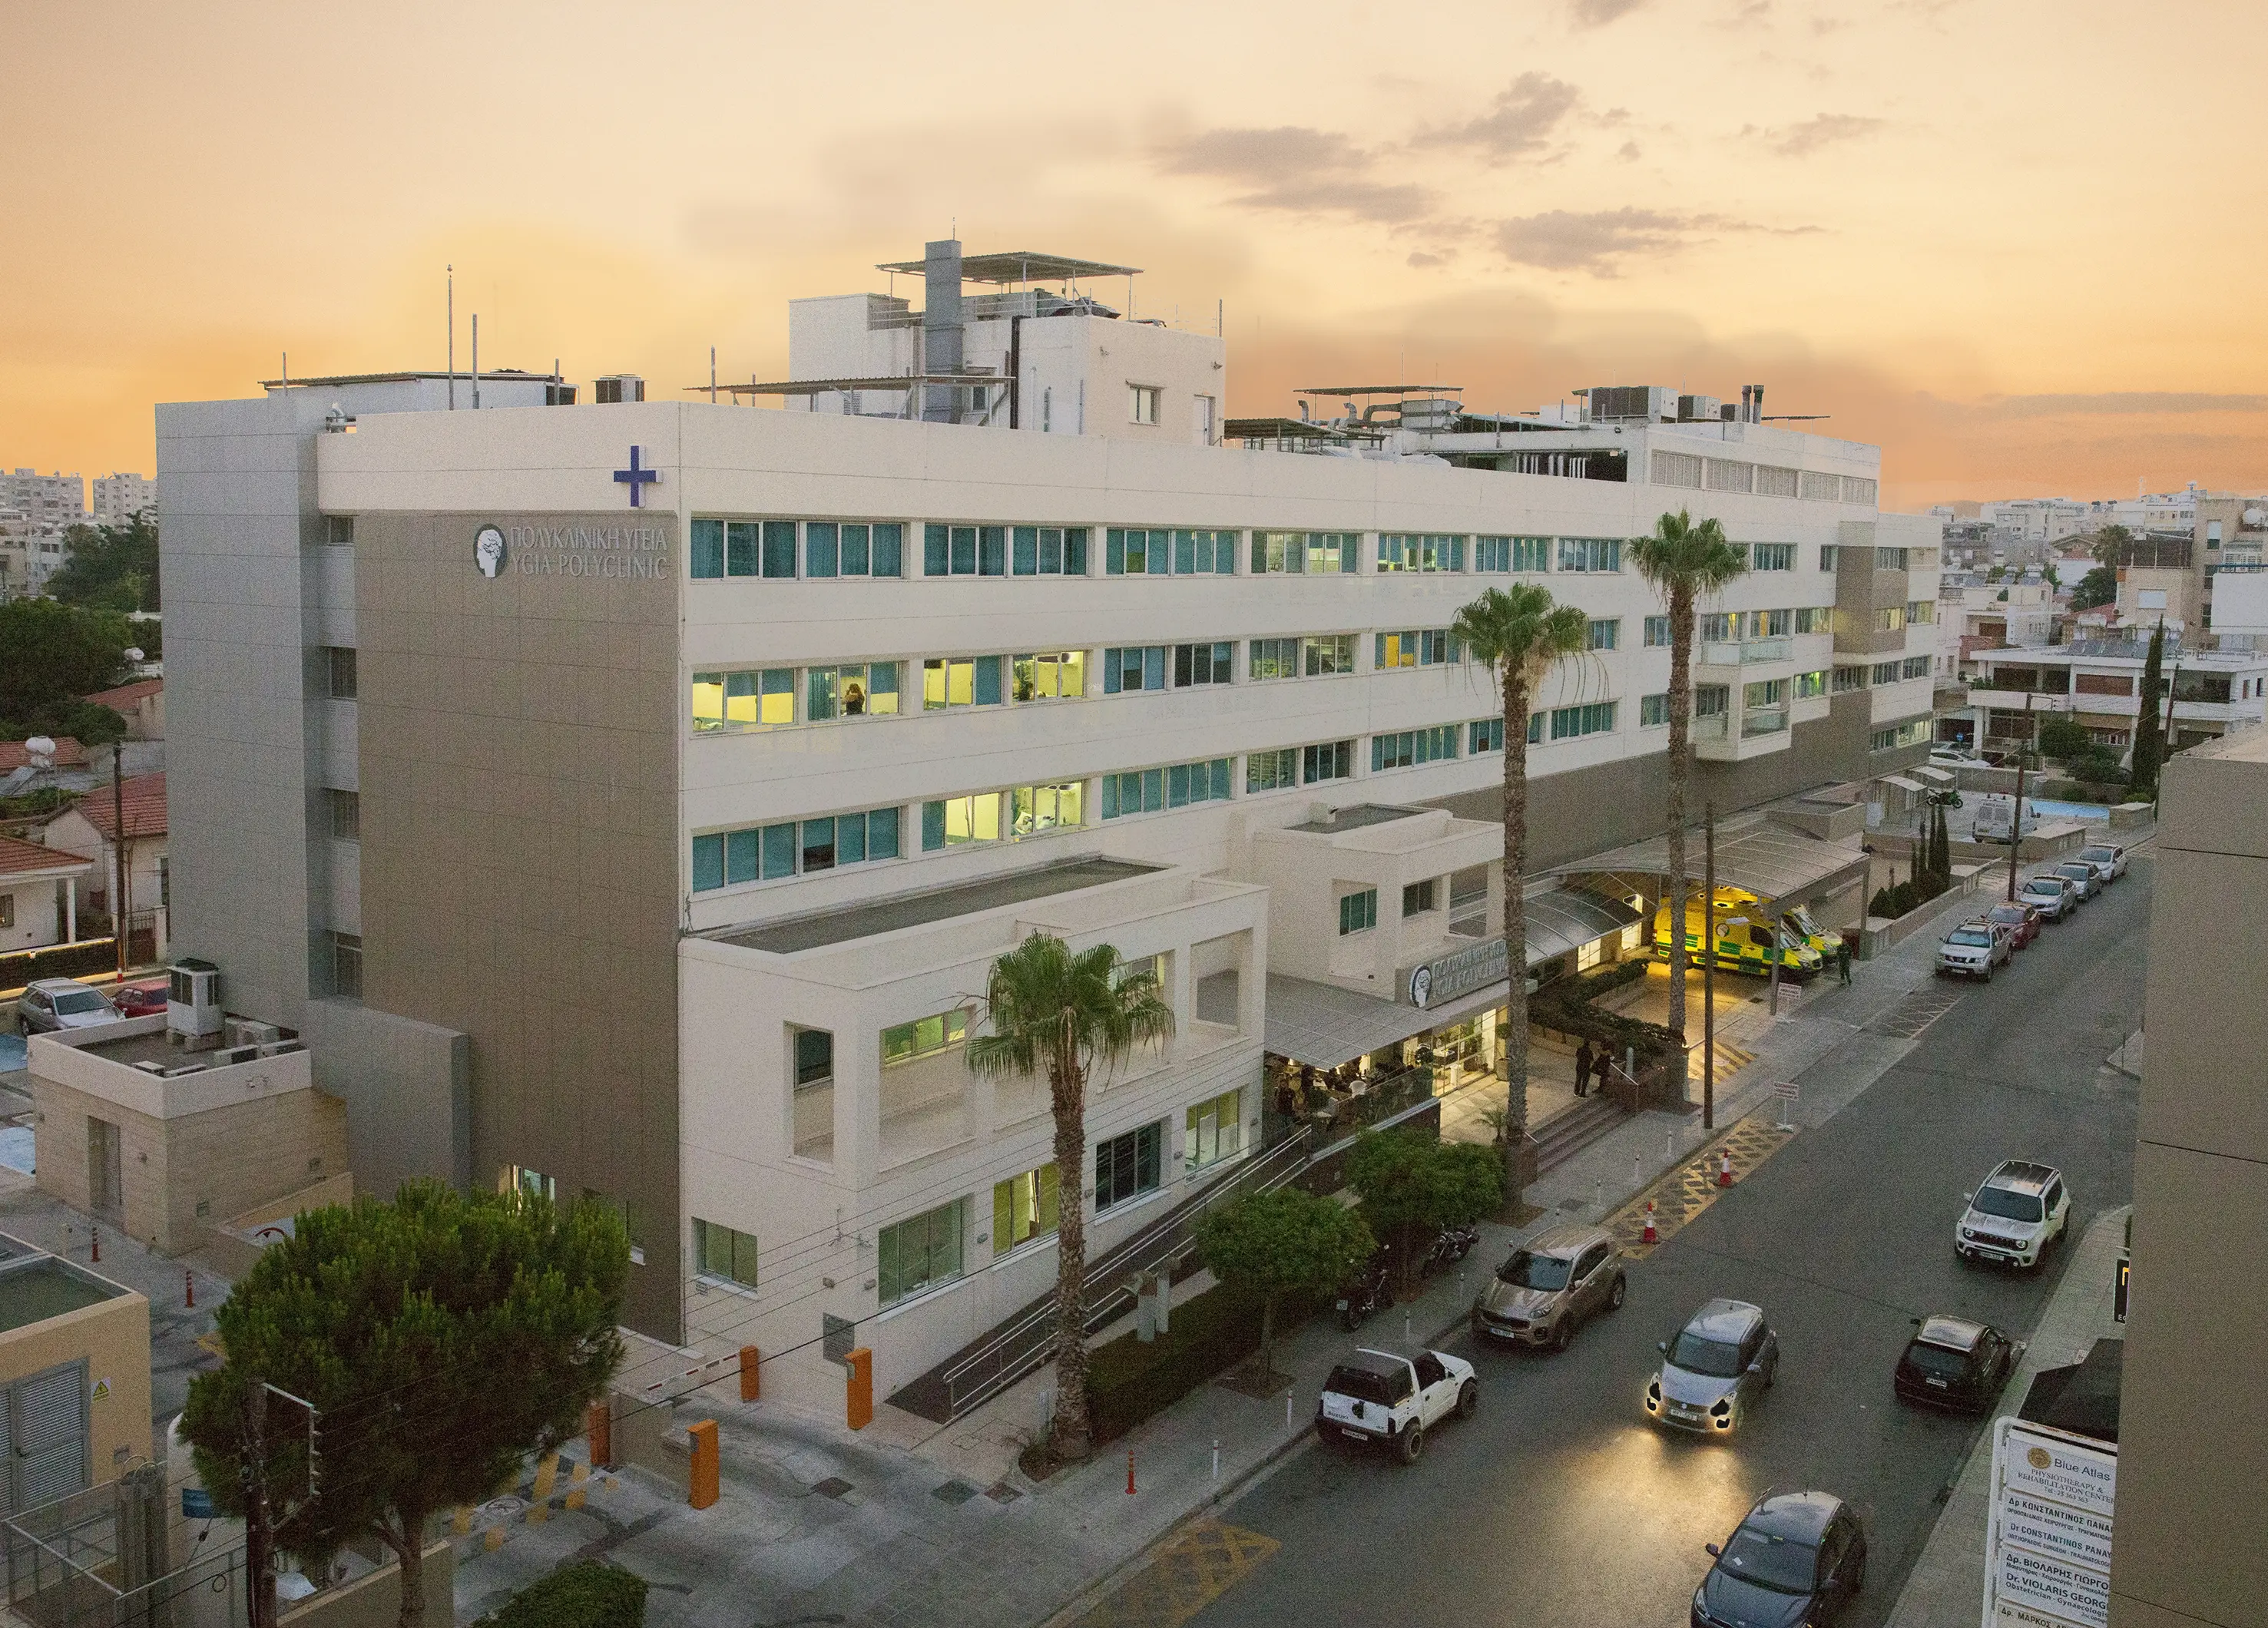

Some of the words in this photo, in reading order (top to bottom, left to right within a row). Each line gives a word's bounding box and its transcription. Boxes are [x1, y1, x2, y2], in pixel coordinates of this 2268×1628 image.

[510, 527, 620, 550] ΠΟΛΥΚΛΙΝΙΚΗ
[624, 528, 667, 551] ΥΓΕΙΑ
[512, 553, 551, 575] YGIA
[559, 554, 667, 581] POLYCLINIC
[1327, 1411, 1349, 1420] SUZUKI
[2031, 1468, 2096, 1491] PHYSIOTHERAPY
[2054, 1458, 2079, 1473] Blue
[2081, 1466, 2111, 1481] Atlas
[2018, 1472, 2083, 1495] REHABILITATION
[2008, 1497, 2019, 1507] Δρ
[2022, 1501, 2084, 1525] ΚΩΝΣΤΑΝΤΙΝΟΣ
[2011, 1523, 2019, 1531] Dr
[2021, 1526, 2083, 1550] CONSTANTINOS
[2006, 1554, 2022, 1564] Δρ.
[2024, 1558, 2072, 1580] ΒΙΟΛΑΡΗΣ
[2005, 1581, 2051, 1600] Obstetrician
[2006, 1572, 2020, 1583] Dr.
[2022, 1577, 2068, 1598] VIOLARIS
[2070, 1592, 2106, 1610] GEORG
[2001, 1606, 2014, 1616] Δρ.
[2018, 1611, 2051, 1628] ΜΑΡΚΟΣ
